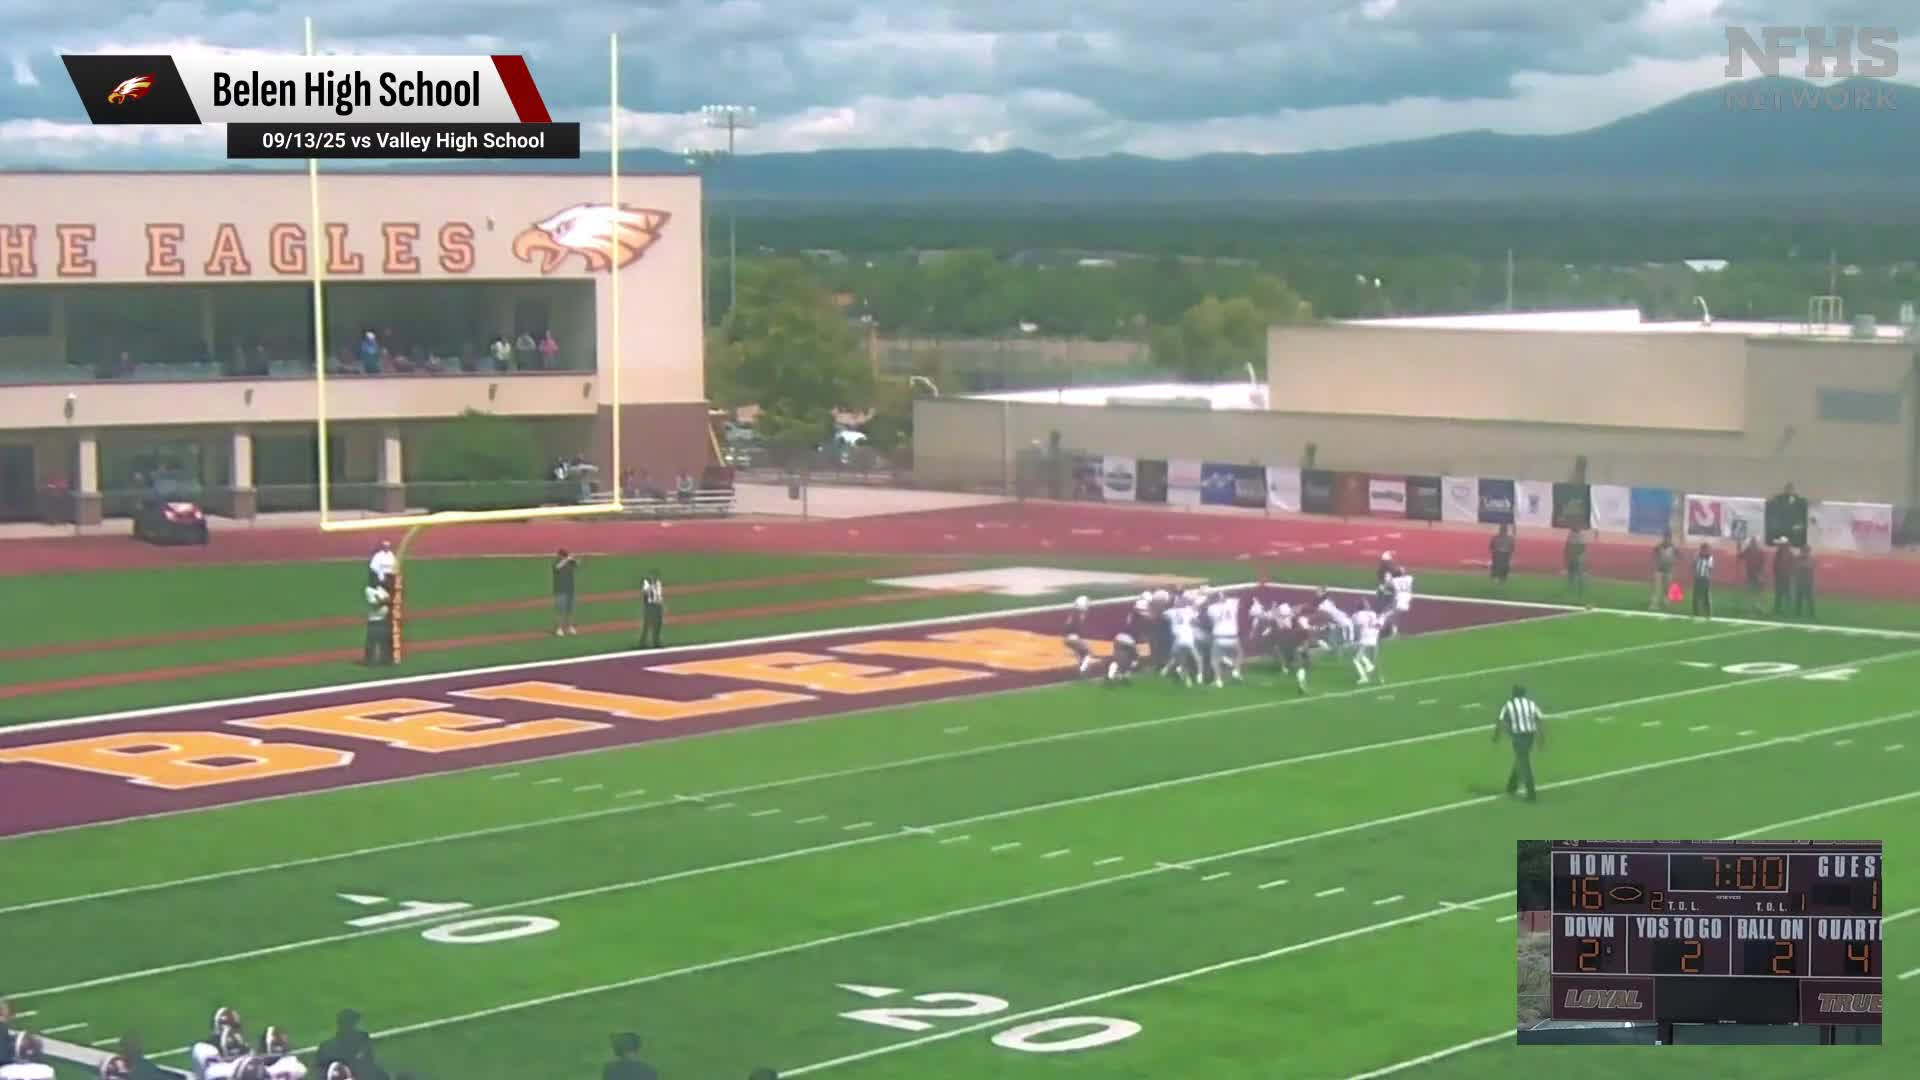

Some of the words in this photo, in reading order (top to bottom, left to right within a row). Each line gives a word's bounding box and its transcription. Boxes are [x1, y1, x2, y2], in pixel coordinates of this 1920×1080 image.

[1569, 854, 1628, 876] HOME
[1702, 855, 1784, 889] 7:00
[1817, 855, 1882, 878] GUES
[1571, 876, 1602, 910] 16
[1650, 891, 1664, 910] 2
[343, 900, 561, 943] 10
[1564, 916, 1615, 938] DOWN
[1635, 917, 1670, 938] YDS
[1673, 917, 1695, 939] TO
[1698, 917, 1722, 939] GO
[1737, 918, 1775, 940] BALL
[1780, 919, 1804, 940] ON
[1817, 919, 1882, 940] QUART
[1579, 938, 1600, 972] 2
[1680, 940, 1701, 973] 2
[1772, 941, 1793, 974] 2
[1847, 943, 1869, 974] 4
[1563, 989, 1643, 1009] LOYAL
[837, 991, 1142, 1051] 20
